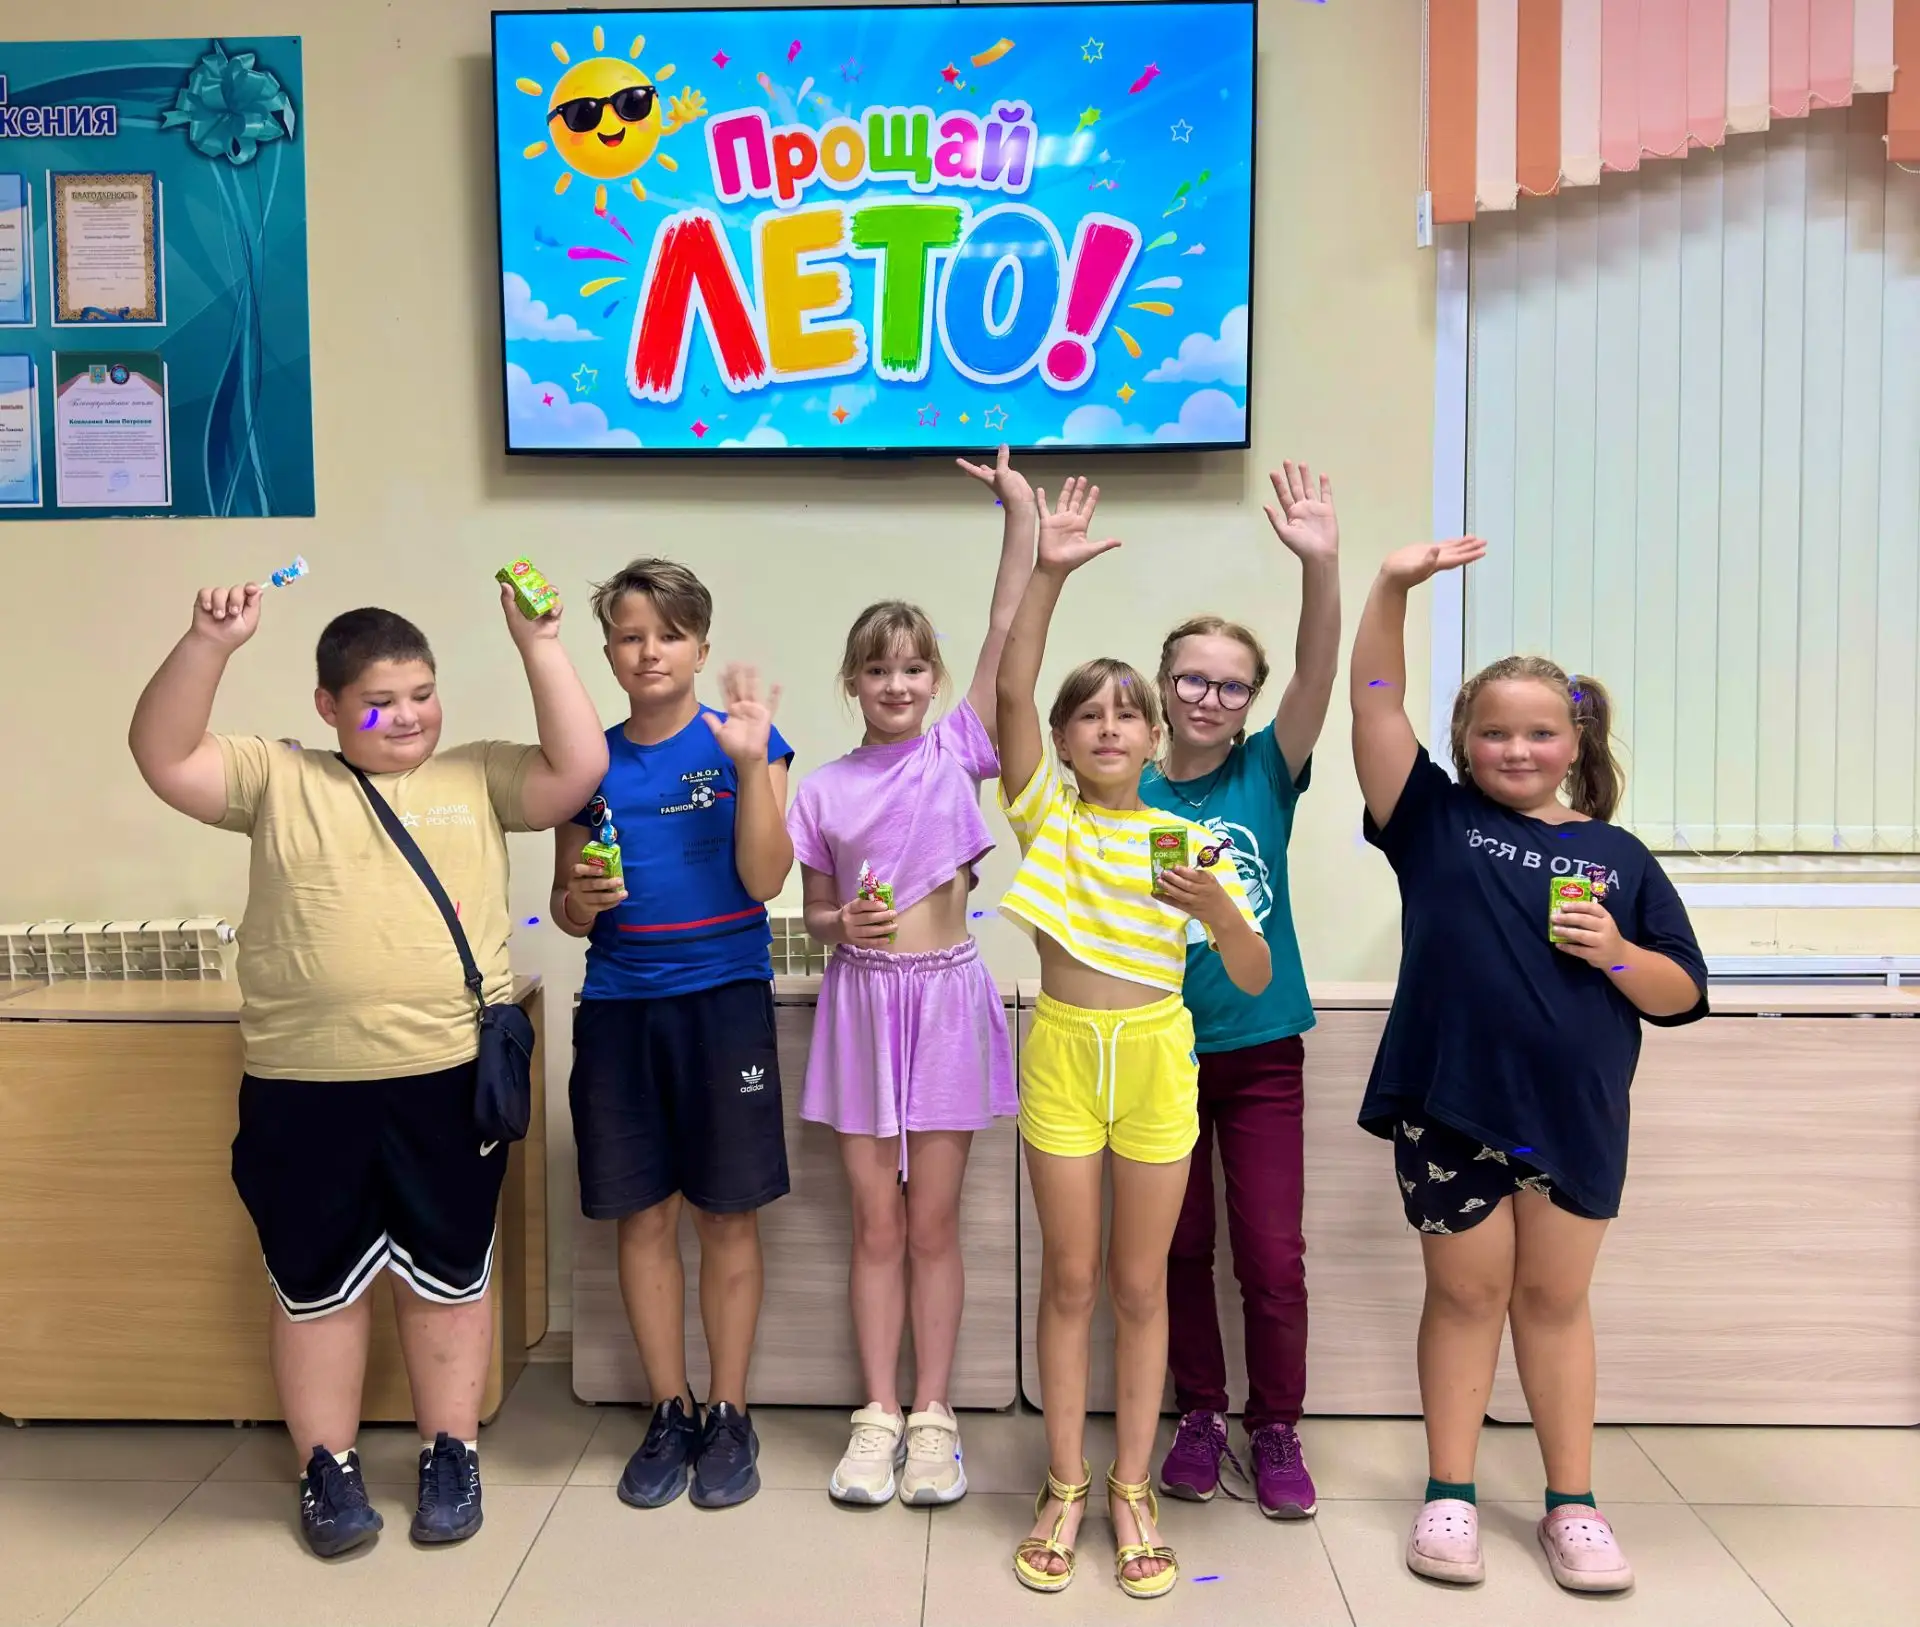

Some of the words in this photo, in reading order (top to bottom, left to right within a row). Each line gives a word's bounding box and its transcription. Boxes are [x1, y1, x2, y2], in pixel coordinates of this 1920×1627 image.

[708, 104, 1035, 204] Прощай
[629, 201, 1142, 400] ЛЕТО!
[426, 804, 469, 815] АРМИЯ
[660, 803, 694, 815] FASHION
[426, 814, 476, 826] РОССИИ
[1522, 850, 1542, 869] В
[740, 1084, 764, 1093] adidas
